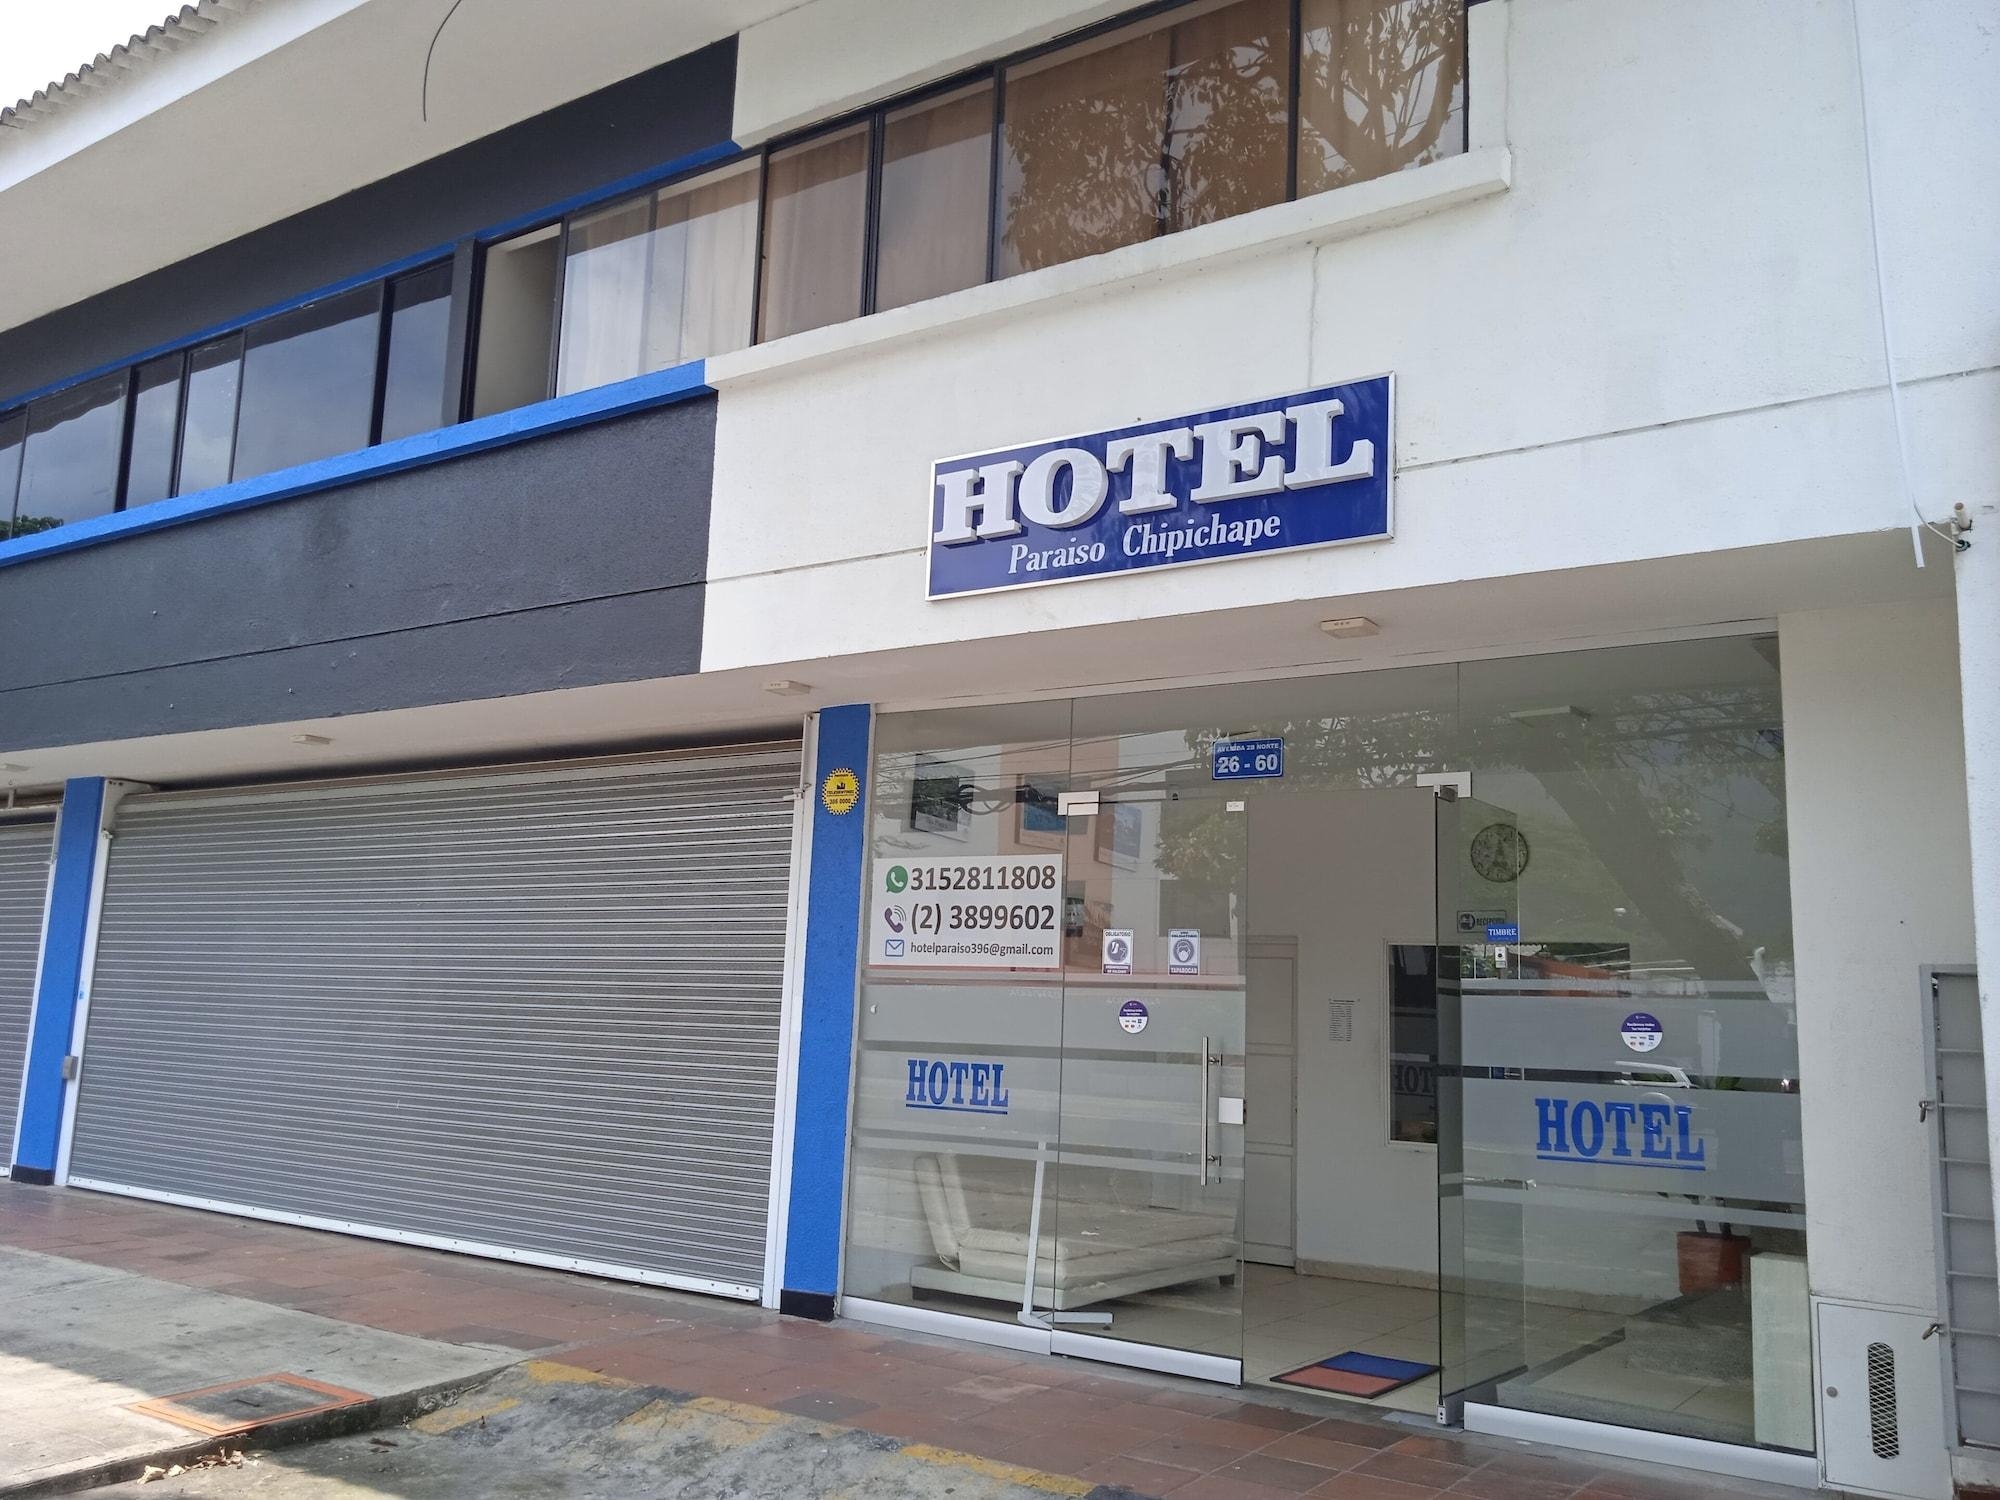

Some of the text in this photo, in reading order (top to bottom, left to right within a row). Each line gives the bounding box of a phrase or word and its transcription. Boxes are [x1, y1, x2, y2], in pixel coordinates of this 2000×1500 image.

[932, 398, 1375, 544] HOTEL
[1008, 513, 1281, 574] Paraiso Chipichape
[1256, 742, 1280, 750] NORTE
[1217, 755, 1240, 774] 26
[1255, 753, 1278, 772] 60
[910, 865, 1056, 891] 3152811808
[911, 903, 1055, 935] (2) 3899602
[1488, 928, 1517, 936] TIMBRE
[910, 942, 1053, 956] hotelparaiso396@gmail.com
[906, 1059, 1009, 1108] HOTEL
[1534, 1098, 1705, 1162] HOTEL
